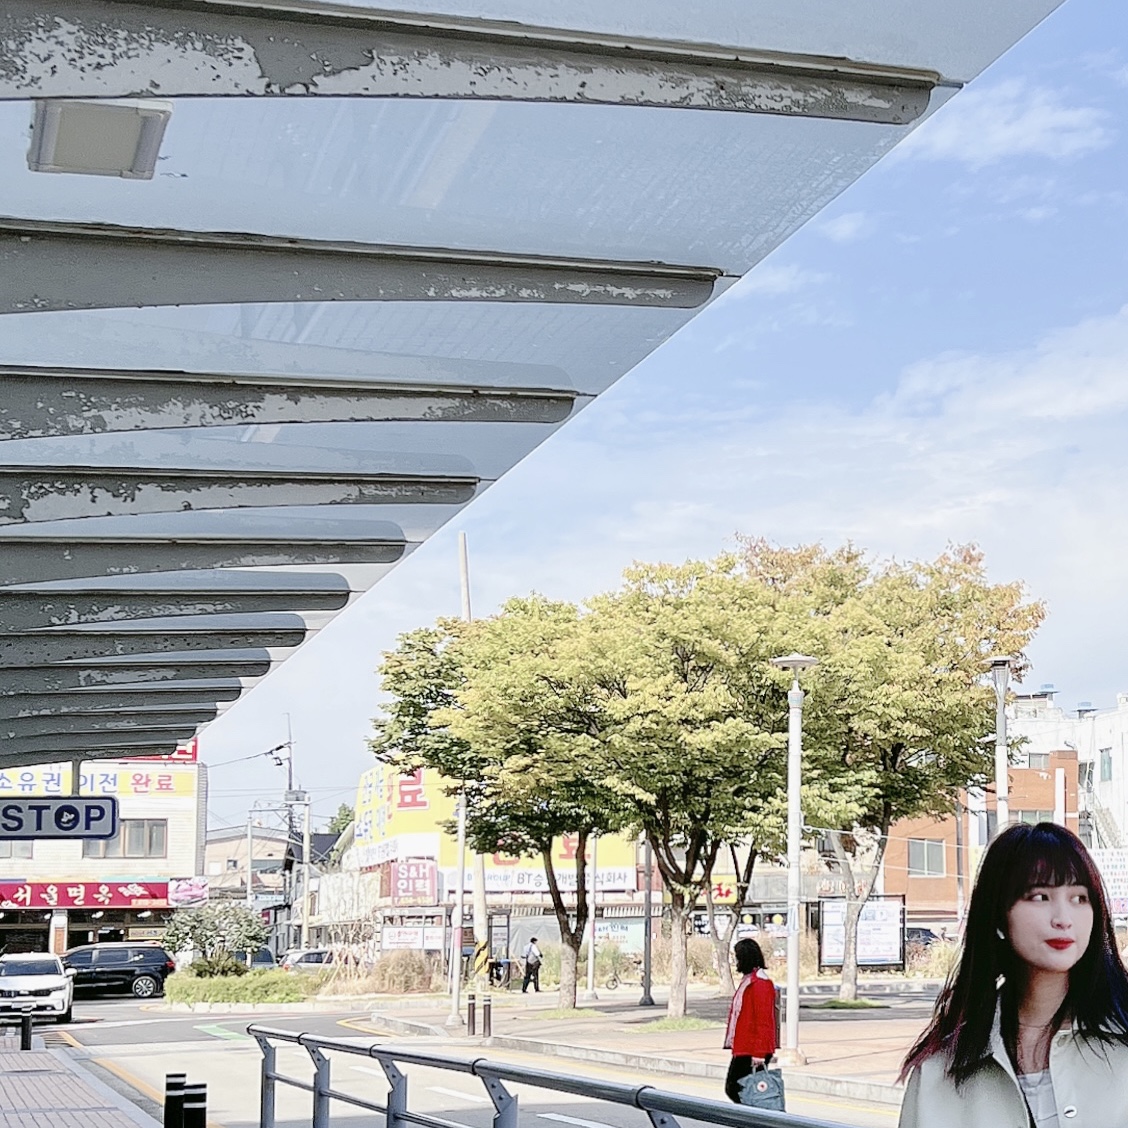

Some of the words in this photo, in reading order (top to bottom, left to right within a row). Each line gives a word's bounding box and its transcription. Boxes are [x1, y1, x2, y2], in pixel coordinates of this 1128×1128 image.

[0, 772, 62, 793] 소유권
[80, 773, 118, 793] 이전
[130, 773, 175, 794] 완료
[1, 804, 106, 832] STOP
[398, 864, 430, 879] S&H
